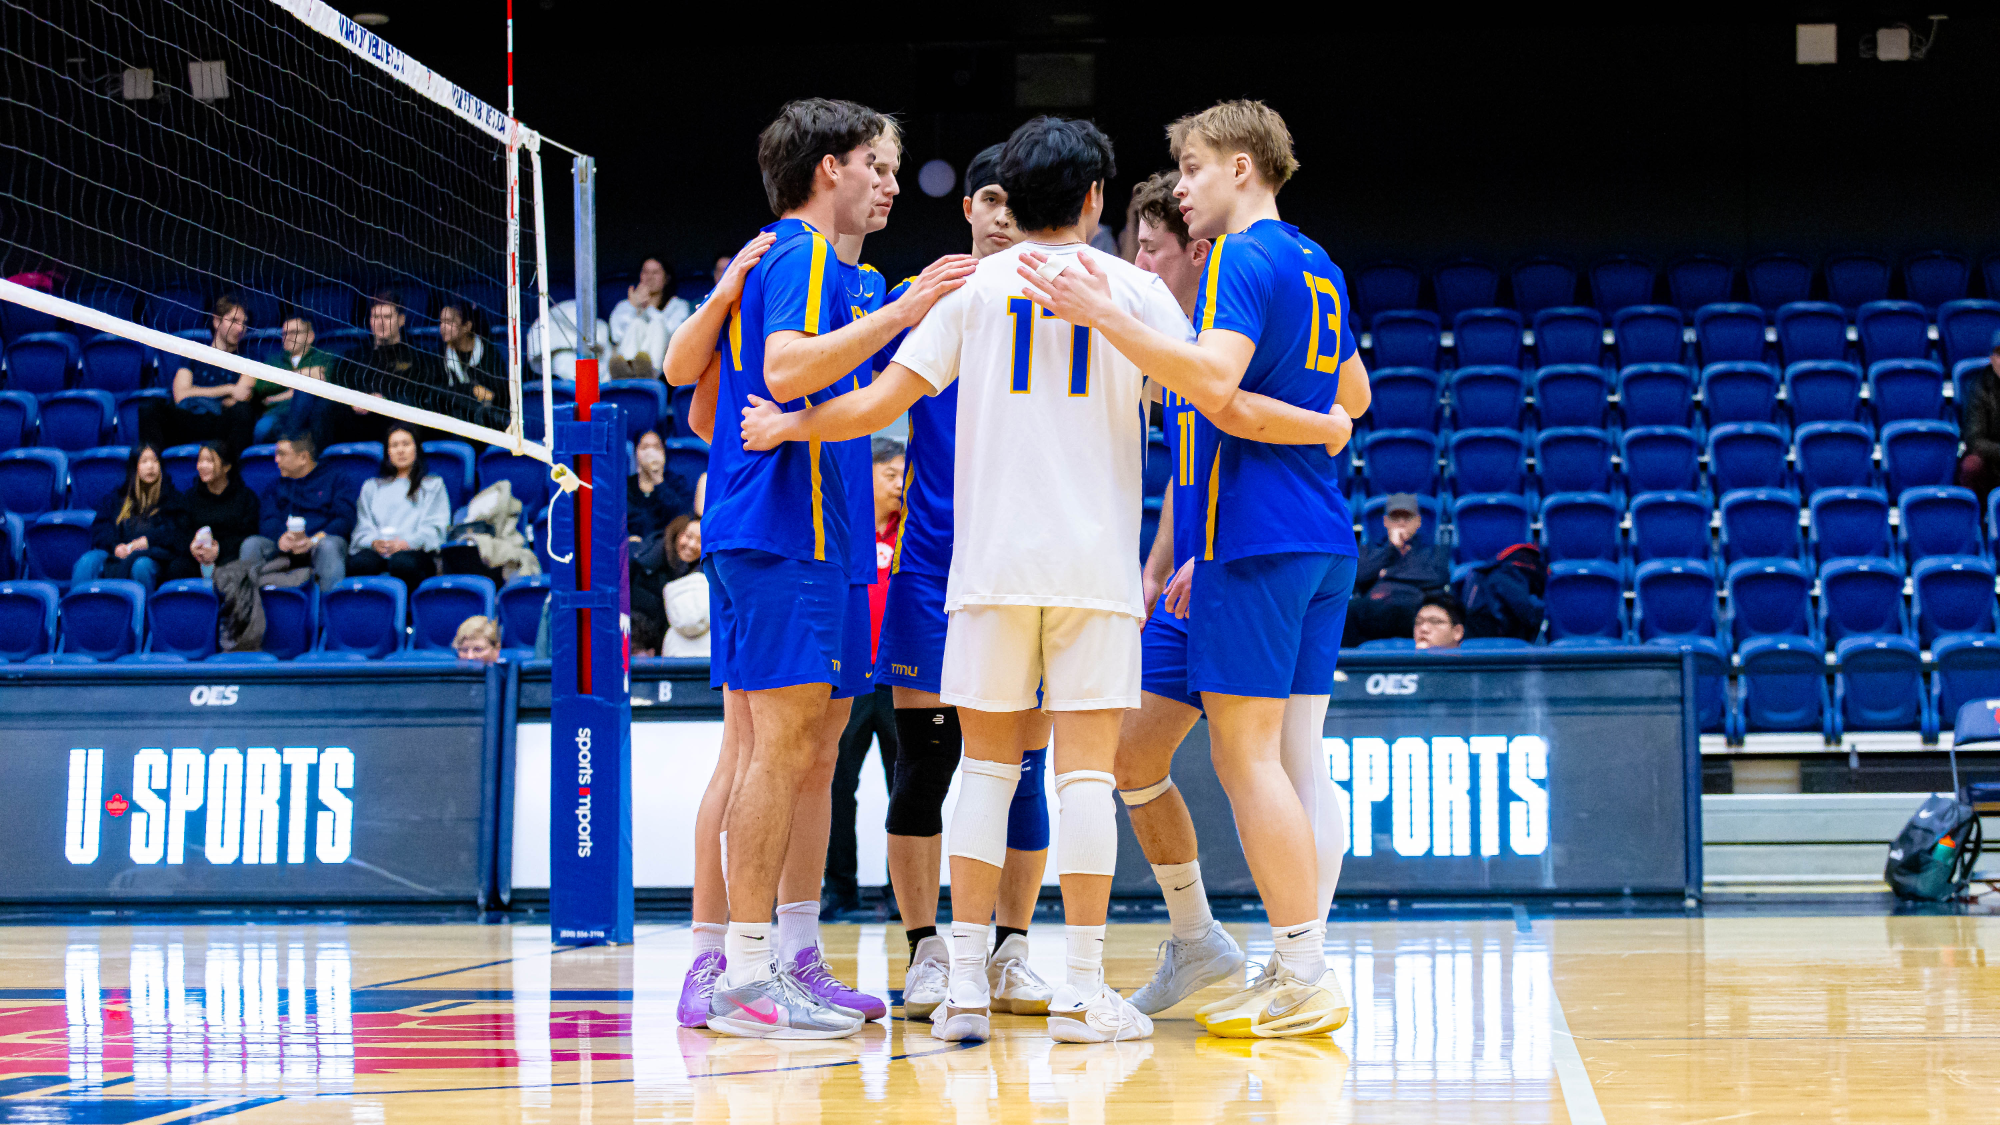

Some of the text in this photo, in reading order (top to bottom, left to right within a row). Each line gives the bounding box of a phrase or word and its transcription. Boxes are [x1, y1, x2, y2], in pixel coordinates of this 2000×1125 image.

[1006, 295, 1093, 398] 17
[1302, 270, 1342, 375] 13
[1177, 410, 1196, 487] 11
[189, 685, 240, 707] OES
[658, 680, 673, 703] B
[1365, 673, 1420, 695] OES
[575, 727, 594, 785] sports
[64, 747, 356, 865] U SPORTS
[1322, 734, 1550, 858] SPORTS
